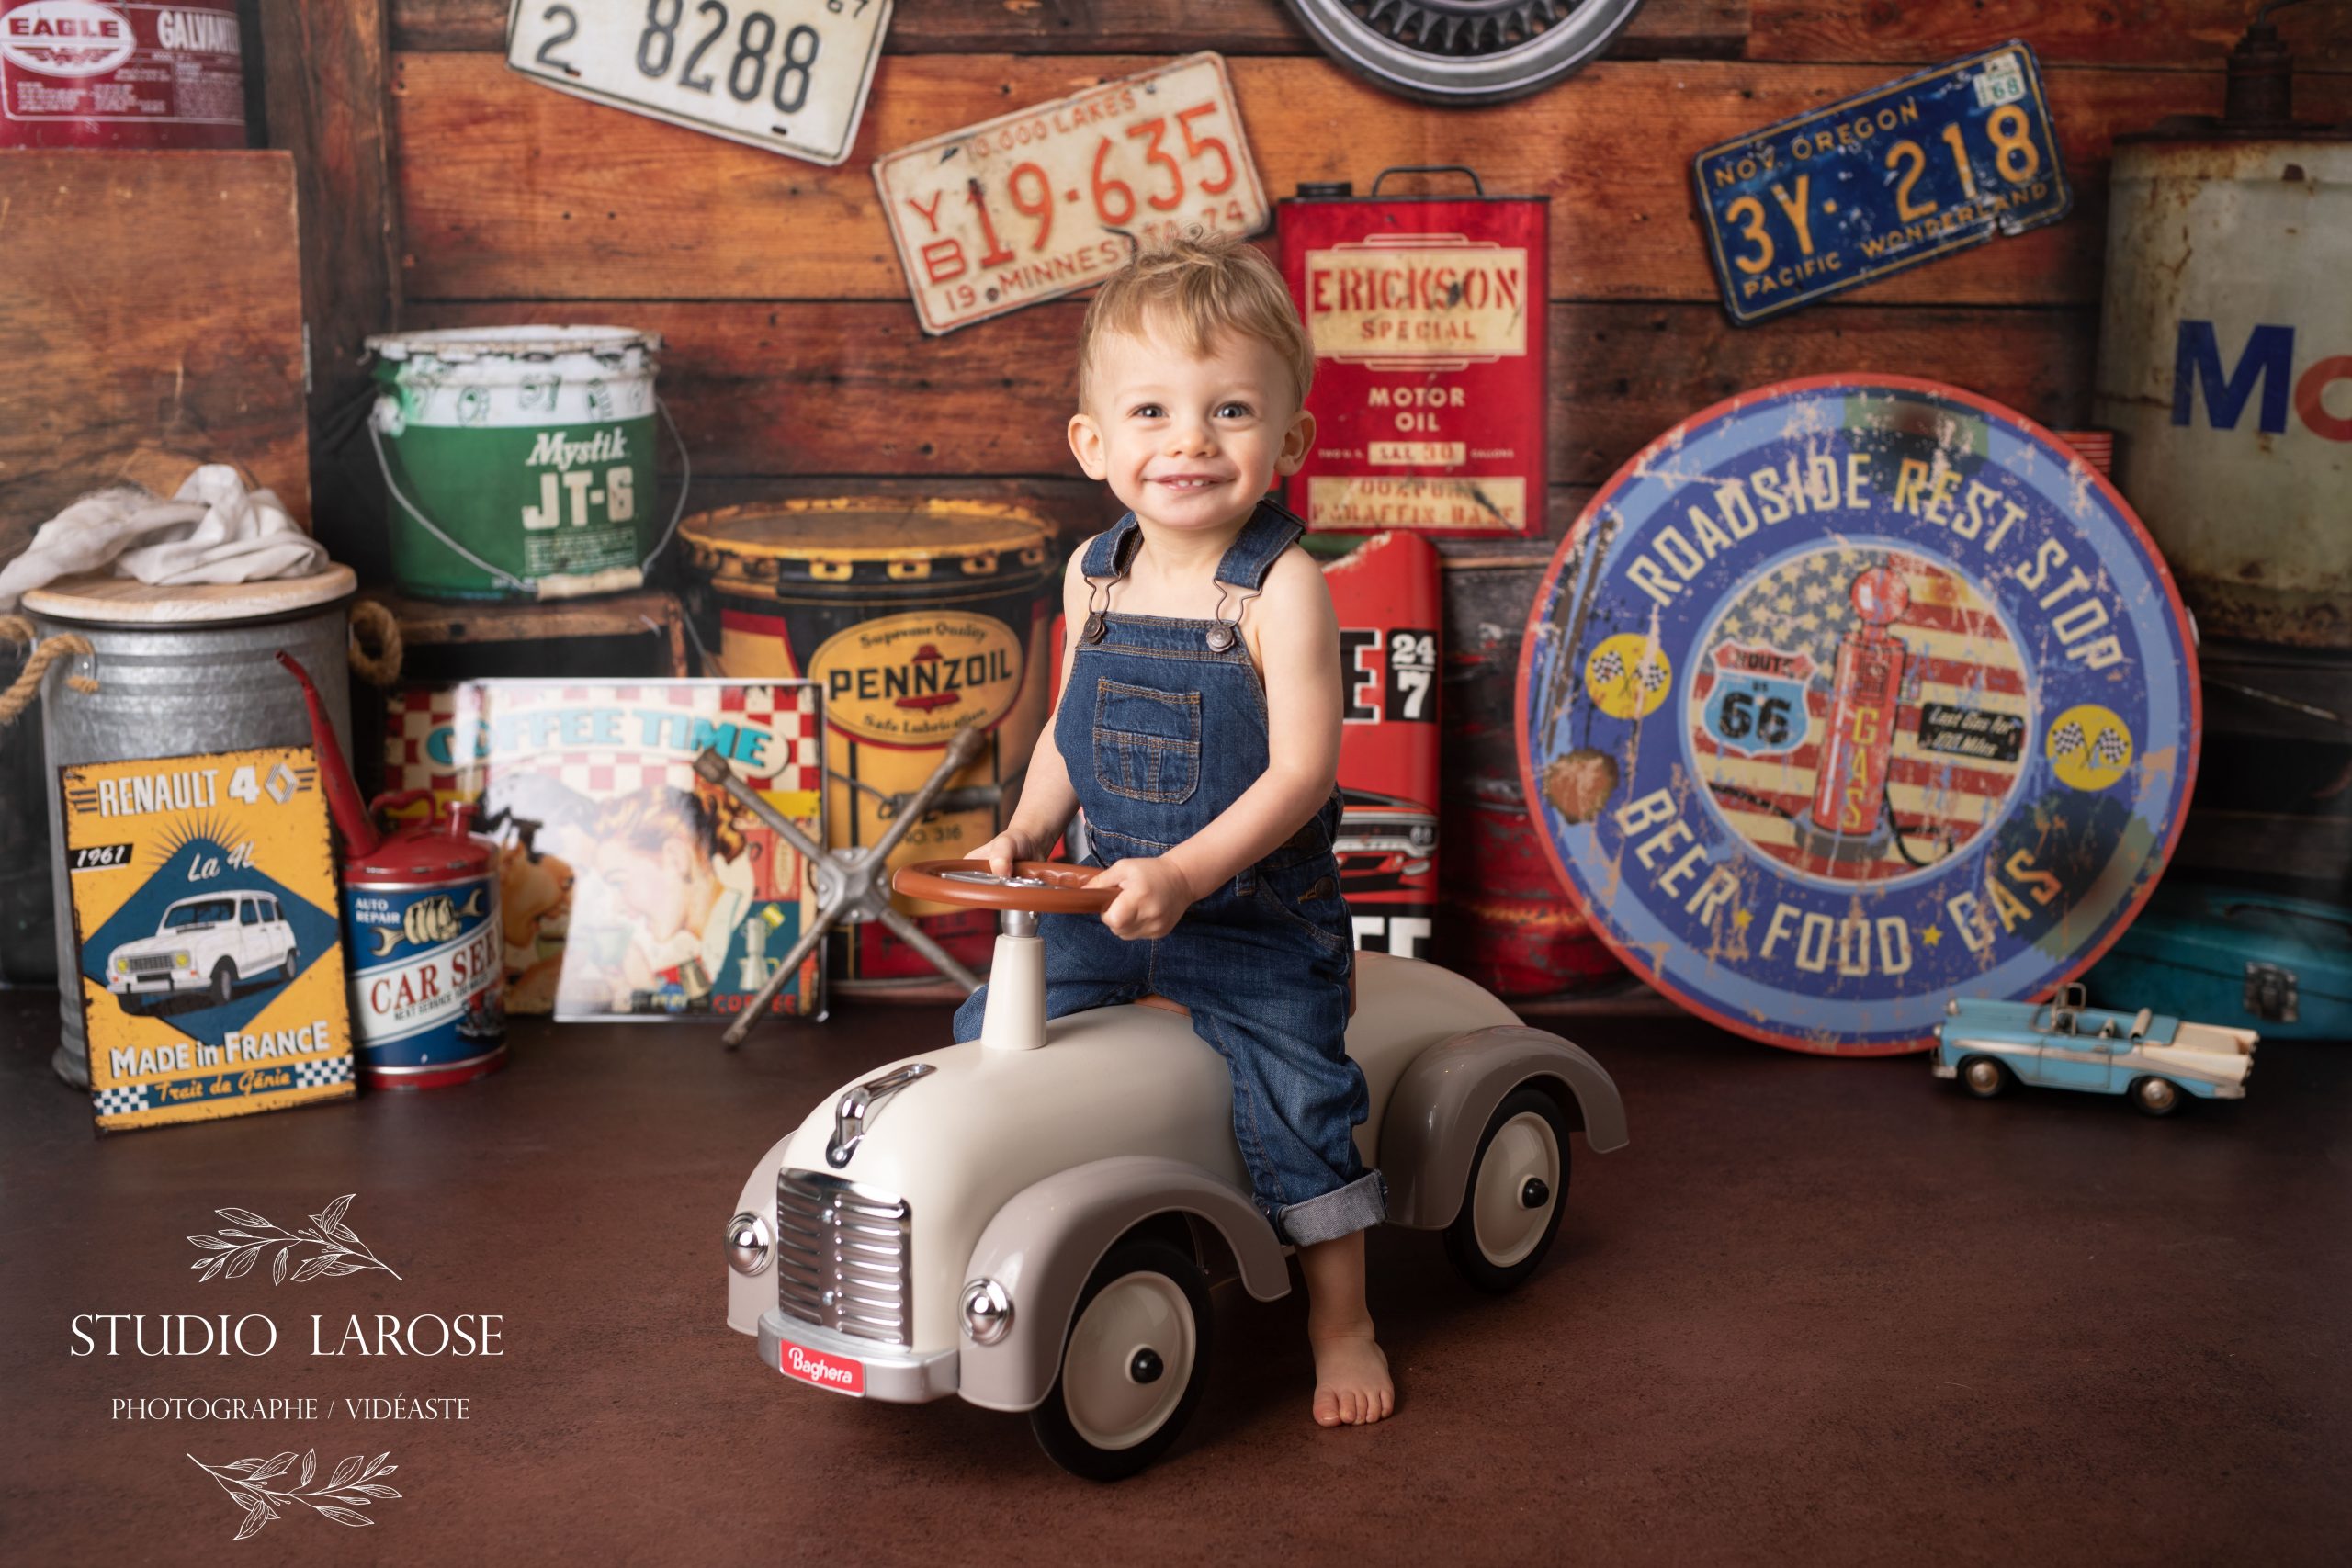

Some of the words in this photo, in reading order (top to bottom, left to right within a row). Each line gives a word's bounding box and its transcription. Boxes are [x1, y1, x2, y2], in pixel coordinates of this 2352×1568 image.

[9, 18, 119, 37] EAGLE
[535, 5, 578, 72] 2
[637, 0, 820, 114] 8288
[1054, 91, 1139, 133] LAKES
[1791, 100, 1920, 160] OREGON
[1885, 105, 2040, 223] 218
[1202, 199, 1246, 230] 74
[1743, 252, 1843, 299] PACIFIC
[1860, 183, 2048, 259] WONDERLAND
[945, 288, 978, 313] 19
[1311, 267, 1520, 313] ERICKSON
[1361, 320, 1476, 341] SPECIAL
[1368, 386, 1466, 408] MOTOR
[1394, 412, 1441, 433] OIL
[525, 426, 628, 472] Mystik
[522, 466, 635, 530] JT-6
[1625, 453, 1871, 607] ROADSIDE
[1894, 457, 2028, 554] REST
[2017, 537, 2124, 672] STOP
[1391, 634, 1436, 665] 24
[830, 649, 1013, 701] PENNZOIL
[1397, 670, 1432, 718] 7
[637, 710, 774, 768] TIME
[1720, 692, 1792, 745] 66
[1843, 706, 1880, 829] GAS
[97, 769, 219, 818] RENAULT
[228, 765, 261, 804] 4
[76, 848, 125, 869] 1961
[187, 852, 220, 884] La
[227, 840, 256, 869] 4L
[356, 897, 388, 912] AUTO
[1614, 788, 1741, 927] BEER
[1758, 902, 1913, 976] FOOD
[1946, 848, 2063, 953] GAS
[356, 912, 401, 925] REPAIR
[370, 964, 441, 1015] CAR
[109, 1043, 191, 1079] MADE
[196, 1043, 219, 1067] in
[223, 1021, 330, 1065] FRANCE
[154, 1080, 206, 1102] Trait
[209, 1074, 232, 1096] de
[239, 1069, 291, 1094] Génie
[788, 1347, 854, 1385] Baghera
